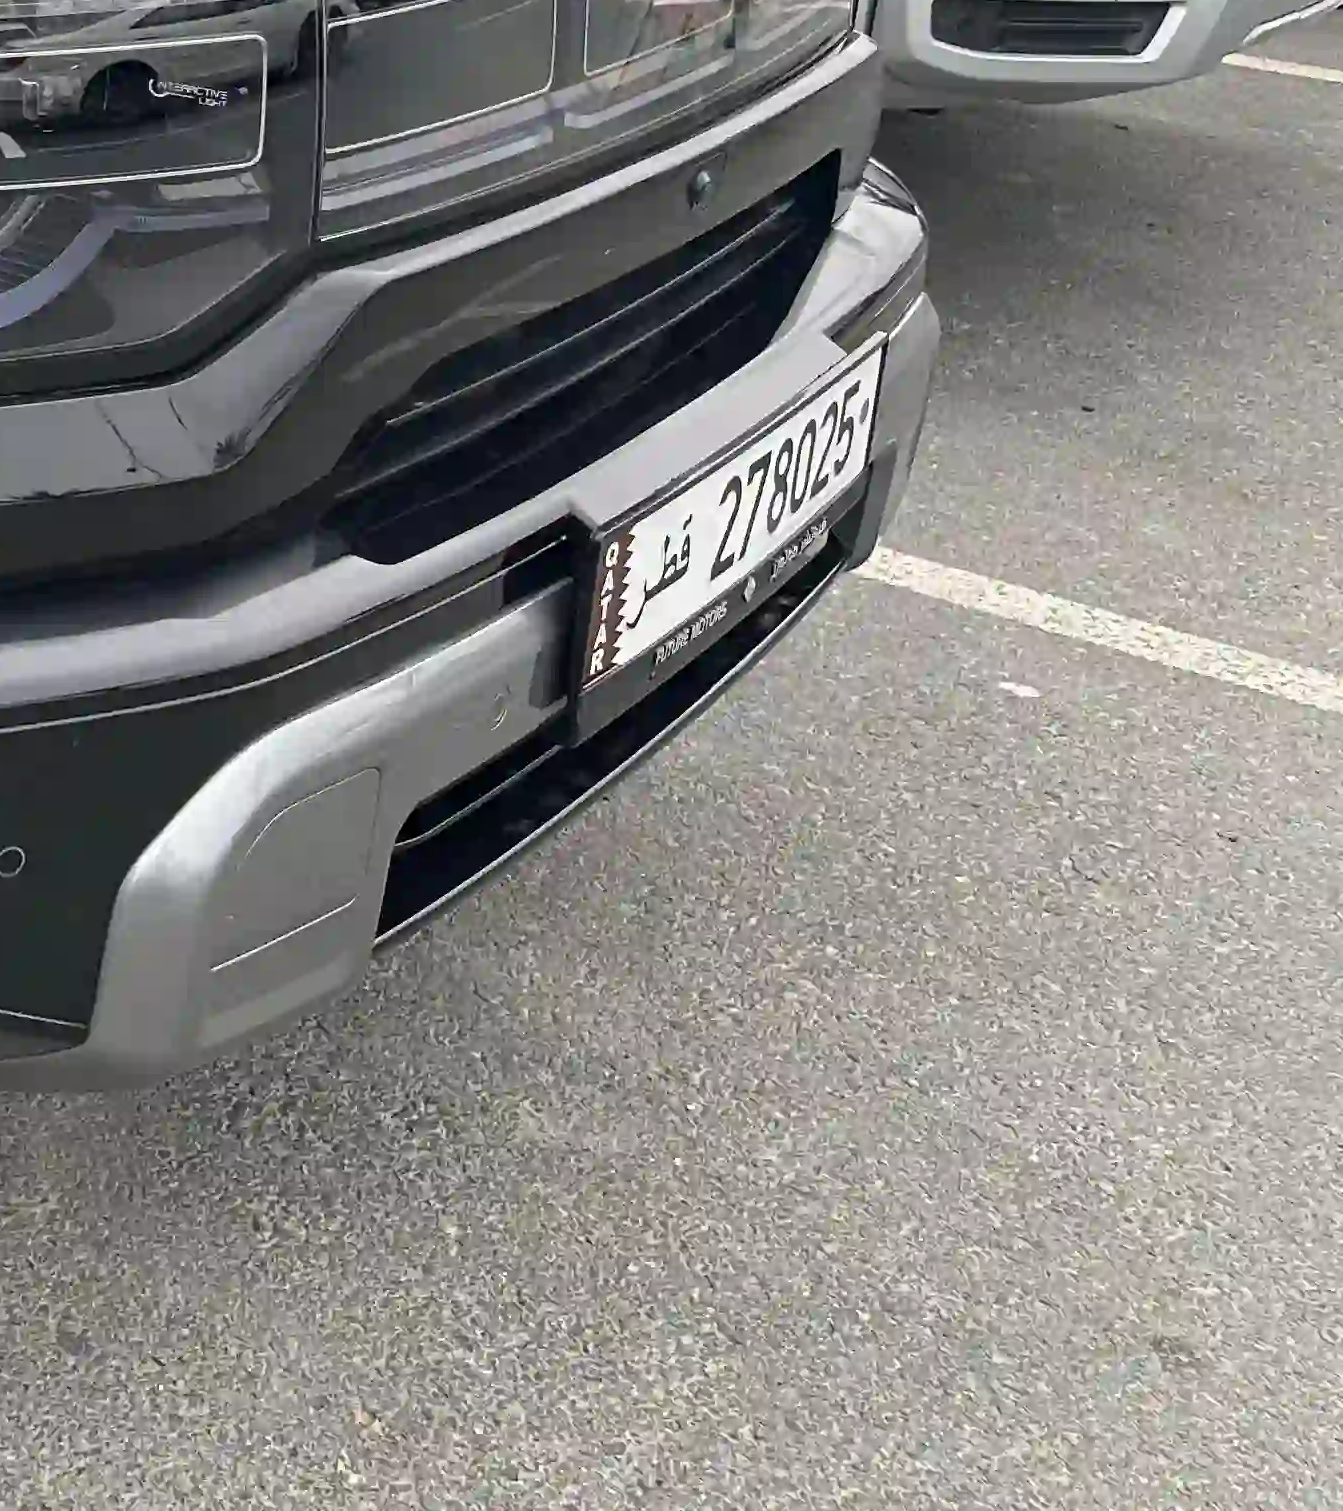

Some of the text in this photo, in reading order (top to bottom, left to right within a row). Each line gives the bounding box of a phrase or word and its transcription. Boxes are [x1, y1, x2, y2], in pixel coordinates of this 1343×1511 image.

[710, 379, 863, 582] 278025
[589, 541, 619, 675] QATAR
[626, 513, 693, 629] قطر
[654, 601, 729, 667] FUTURE MOTORS
